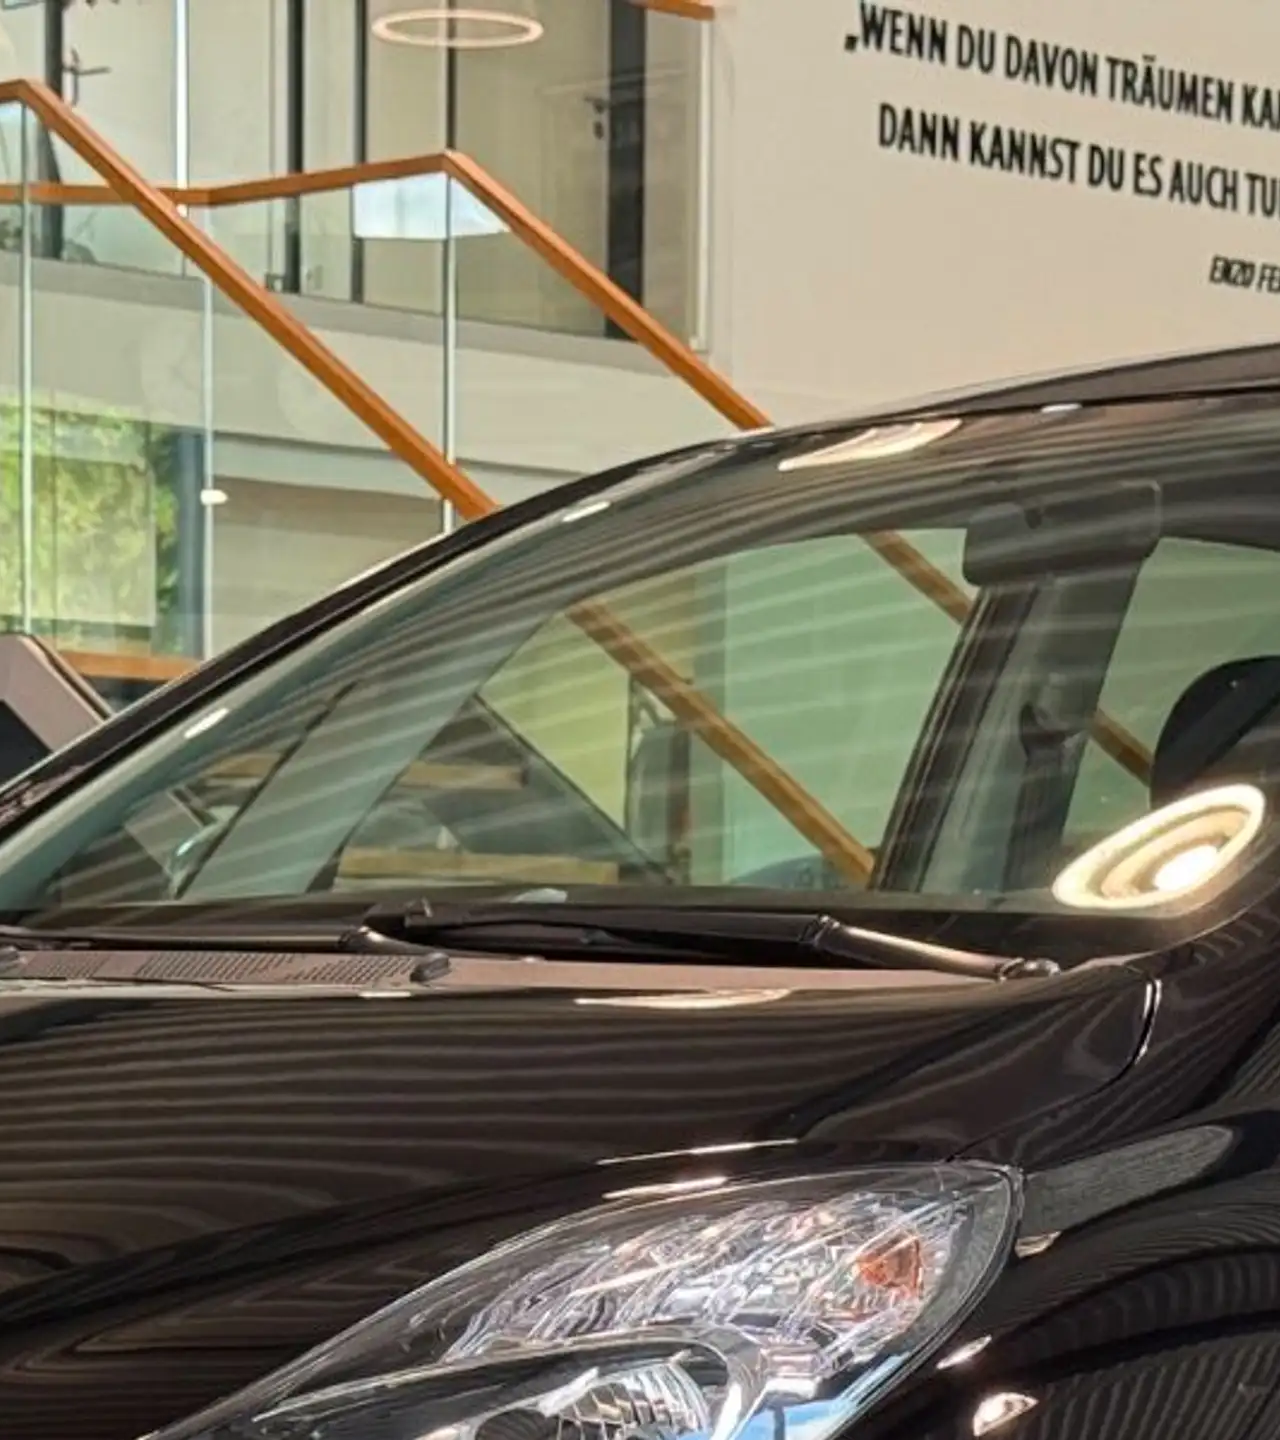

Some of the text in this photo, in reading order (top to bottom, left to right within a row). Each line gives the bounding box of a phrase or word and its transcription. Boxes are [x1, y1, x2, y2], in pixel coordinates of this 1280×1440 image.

[957, 25, 997, 74] DU
[1005, 34, 1099, 96] DAVON
[1106, 55, 1234, 123] TRÄUMEN
[877, 103, 960, 162] DANN
[968, 121, 1080, 184] KANNST
[1087, 146, 1124, 192] DU
[1133, 155, 1162, 198] ES
[1168, 160, 1237, 213] AUCH
[1209, 254, 1255, 288] ENZO
